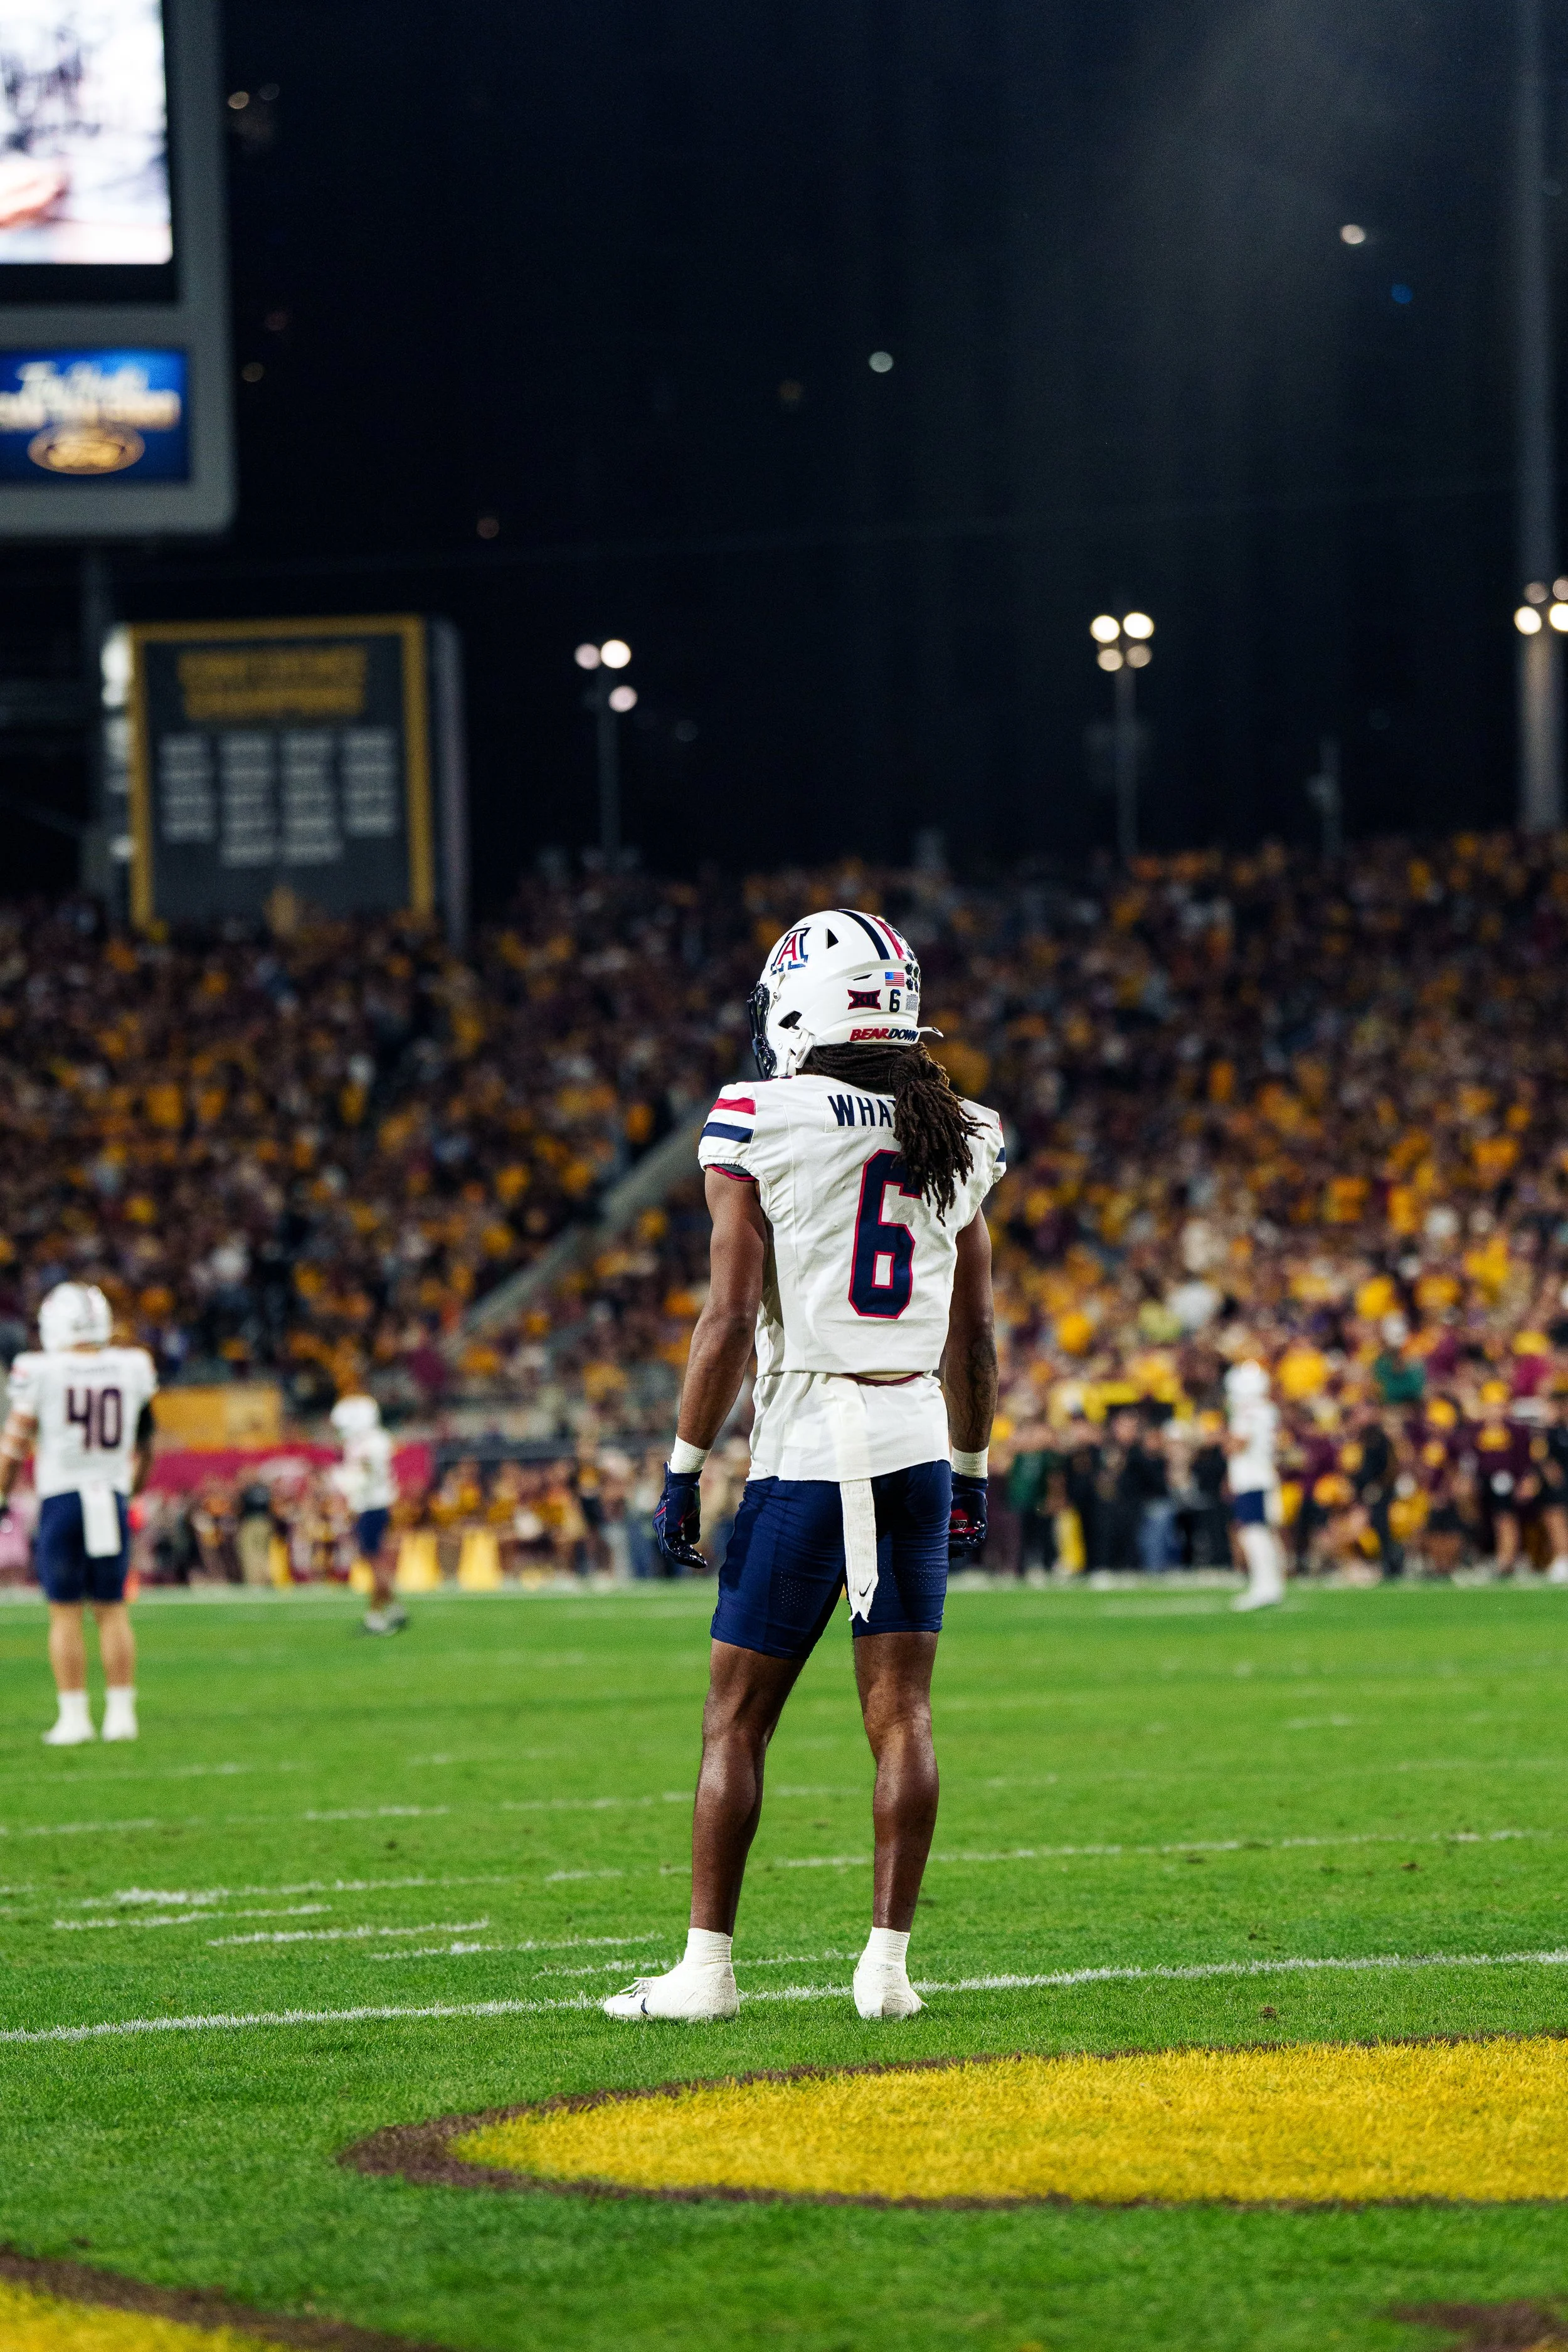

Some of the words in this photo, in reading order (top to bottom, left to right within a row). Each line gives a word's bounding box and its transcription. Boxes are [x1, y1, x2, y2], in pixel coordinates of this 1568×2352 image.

[770, 927, 812, 977] A
[889, 989, 901, 1012] 6
[848, 1149, 924, 1320] 6
[67, 1387, 122, 1449] 40
